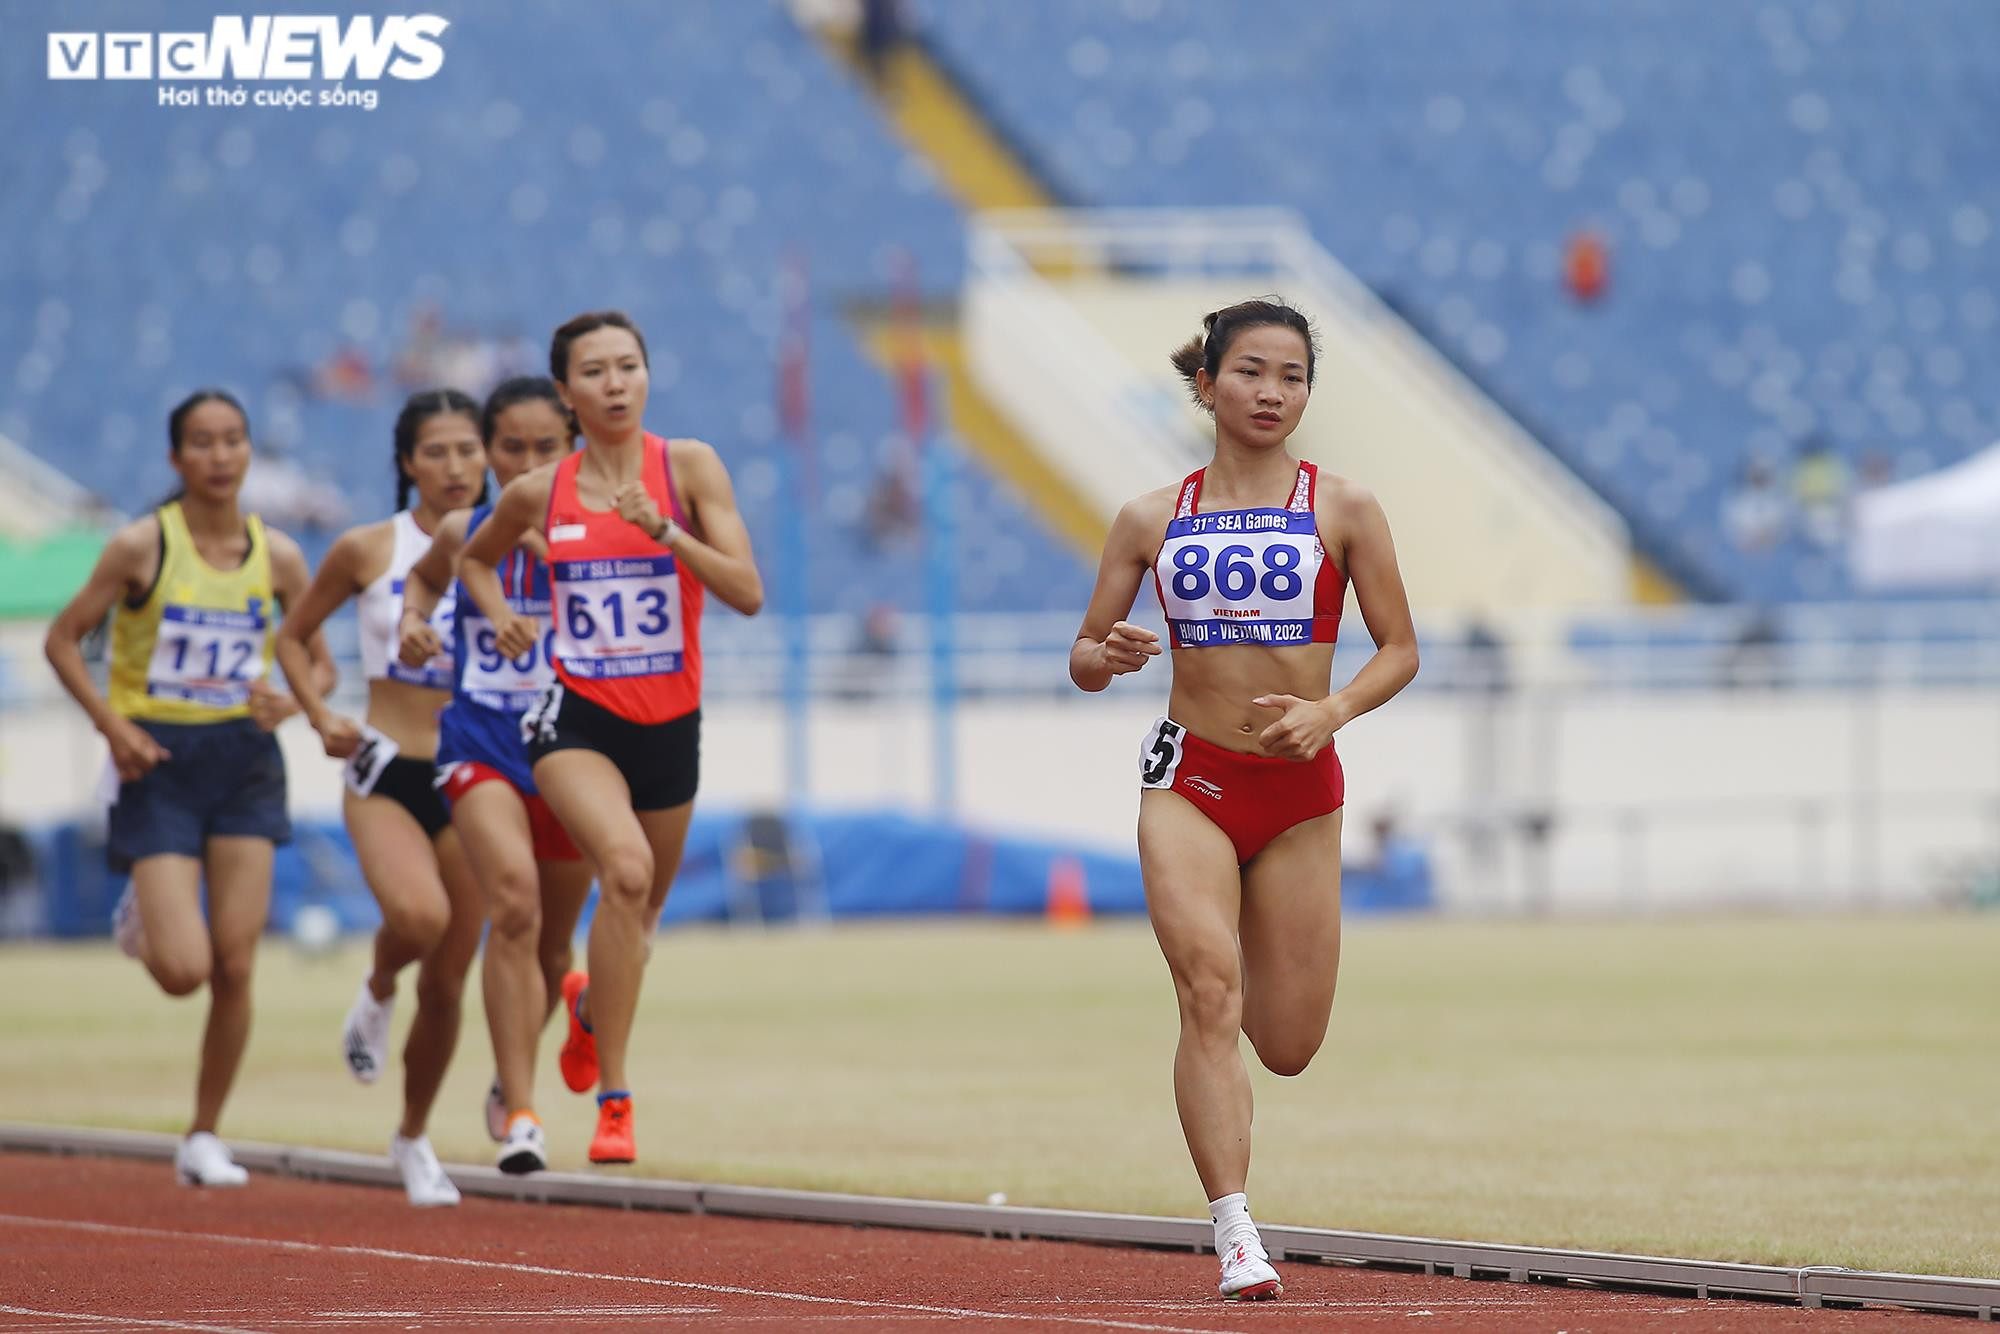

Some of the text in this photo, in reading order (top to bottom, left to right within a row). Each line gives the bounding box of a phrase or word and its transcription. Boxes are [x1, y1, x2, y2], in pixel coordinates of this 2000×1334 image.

[1217, 514, 1242, 530] SEA
[1246, 513, 1288, 530] Games
[590, 561, 613, 577] SEA
[1172, 543, 1303, 601] 868
[567, 588, 670, 640] 613
[1213, 608, 1261, 617] VIETNAM
[1220, 624, 1272, 641] VIETNAM
[1274, 624, 1303, 640] 2022
[170, 635, 254, 681] 112
[1142, 720, 1180, 784] 5
[1183, 779, 1223, 800] LI-NING
